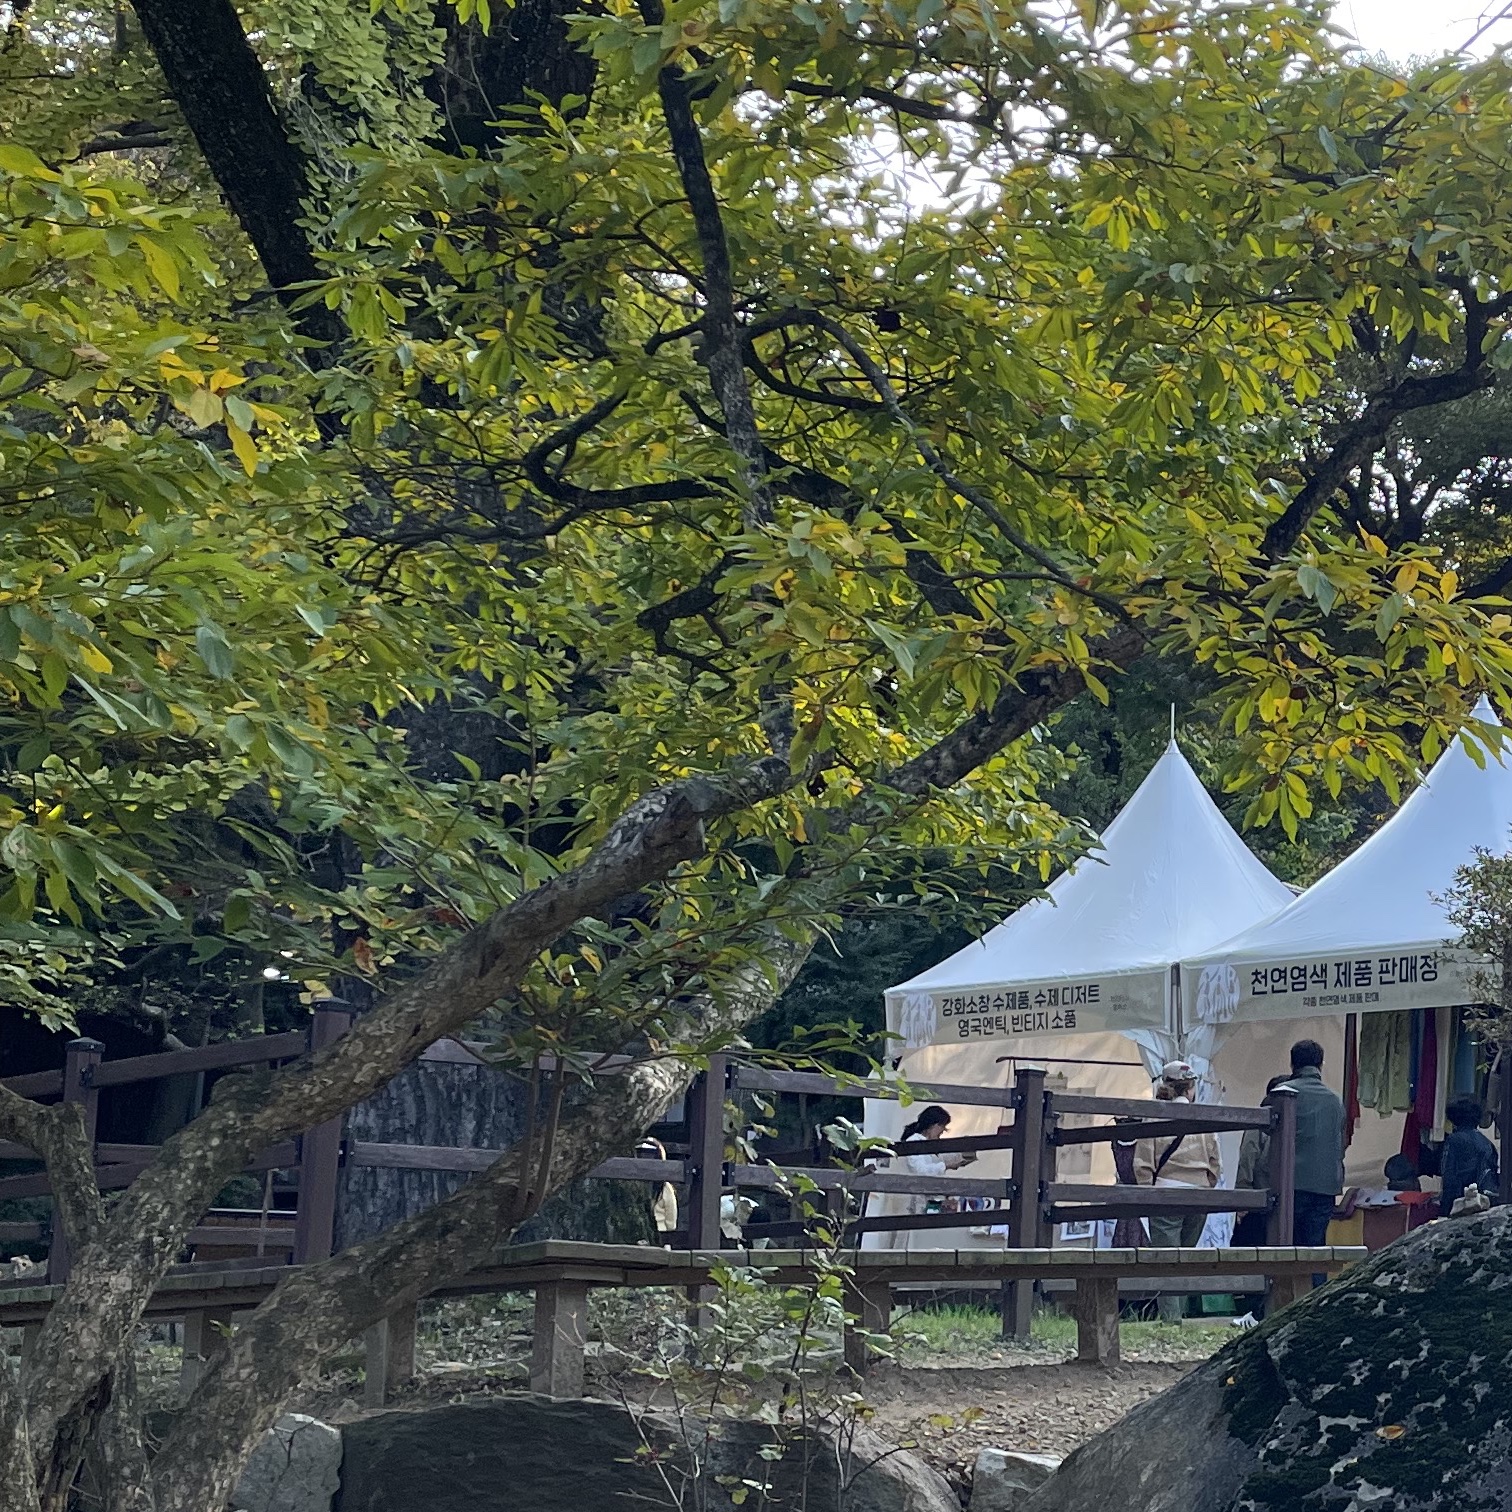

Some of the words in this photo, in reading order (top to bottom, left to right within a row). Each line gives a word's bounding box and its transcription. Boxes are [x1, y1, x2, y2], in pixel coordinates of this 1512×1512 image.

[1251, 962, 1328, 996] 천연염색
[1333, 960, 1373, 988] 제품
[1378, 955, 1438, 985] 판매장
[942, 994, 990, 1017] 강화소창
[992, 990, 1033, 1012] 수제품,
[1034, 987, 1059, 1007] 수제
[1061, 984, 1100, 1006] 디저트
[958, 1014, 1010, 1038] 영국엔틱,
[1011, 1012, 1049, 1033] 빈티지
[1051, 1009, 1076, 1030] 소품
